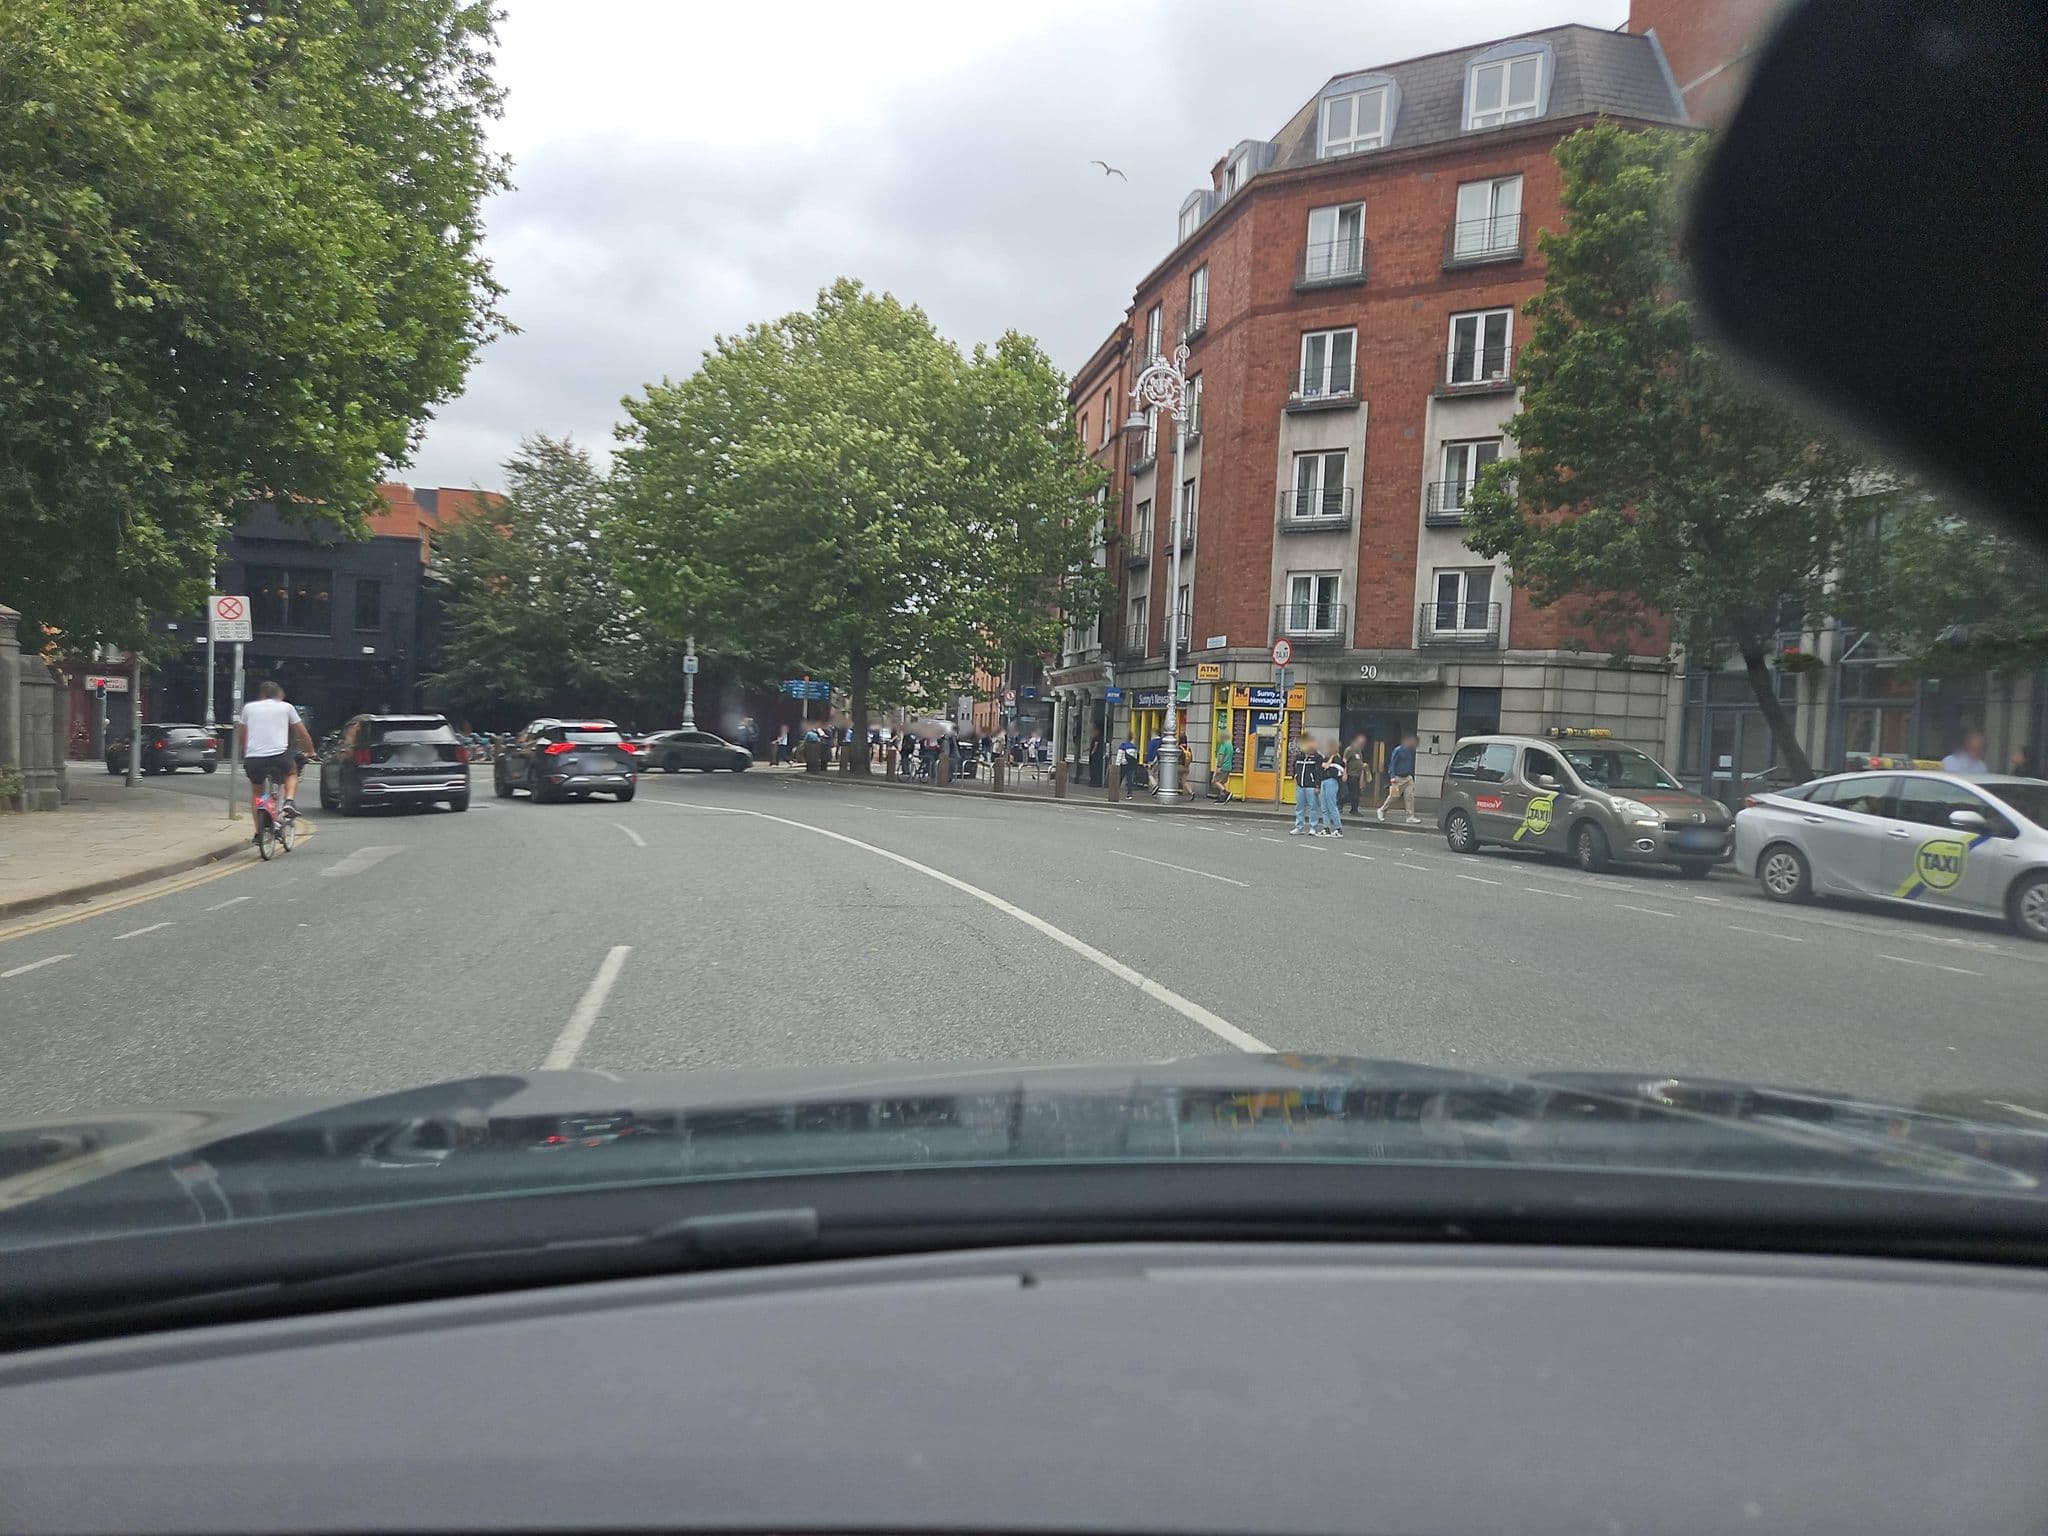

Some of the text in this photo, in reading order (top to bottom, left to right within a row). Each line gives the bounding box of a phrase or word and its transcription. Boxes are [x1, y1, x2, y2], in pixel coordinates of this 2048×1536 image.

[1200, 665, 1219, 673] ATM
[1361, 664, 1377, 679] 20
[1250, 697, 1286, 705] Newsagens
[1259, 712, 1278, 720] ATM
[1529, 808, 1551, 822] TAXI
[1922, 852, 1959, 874] TAXI
